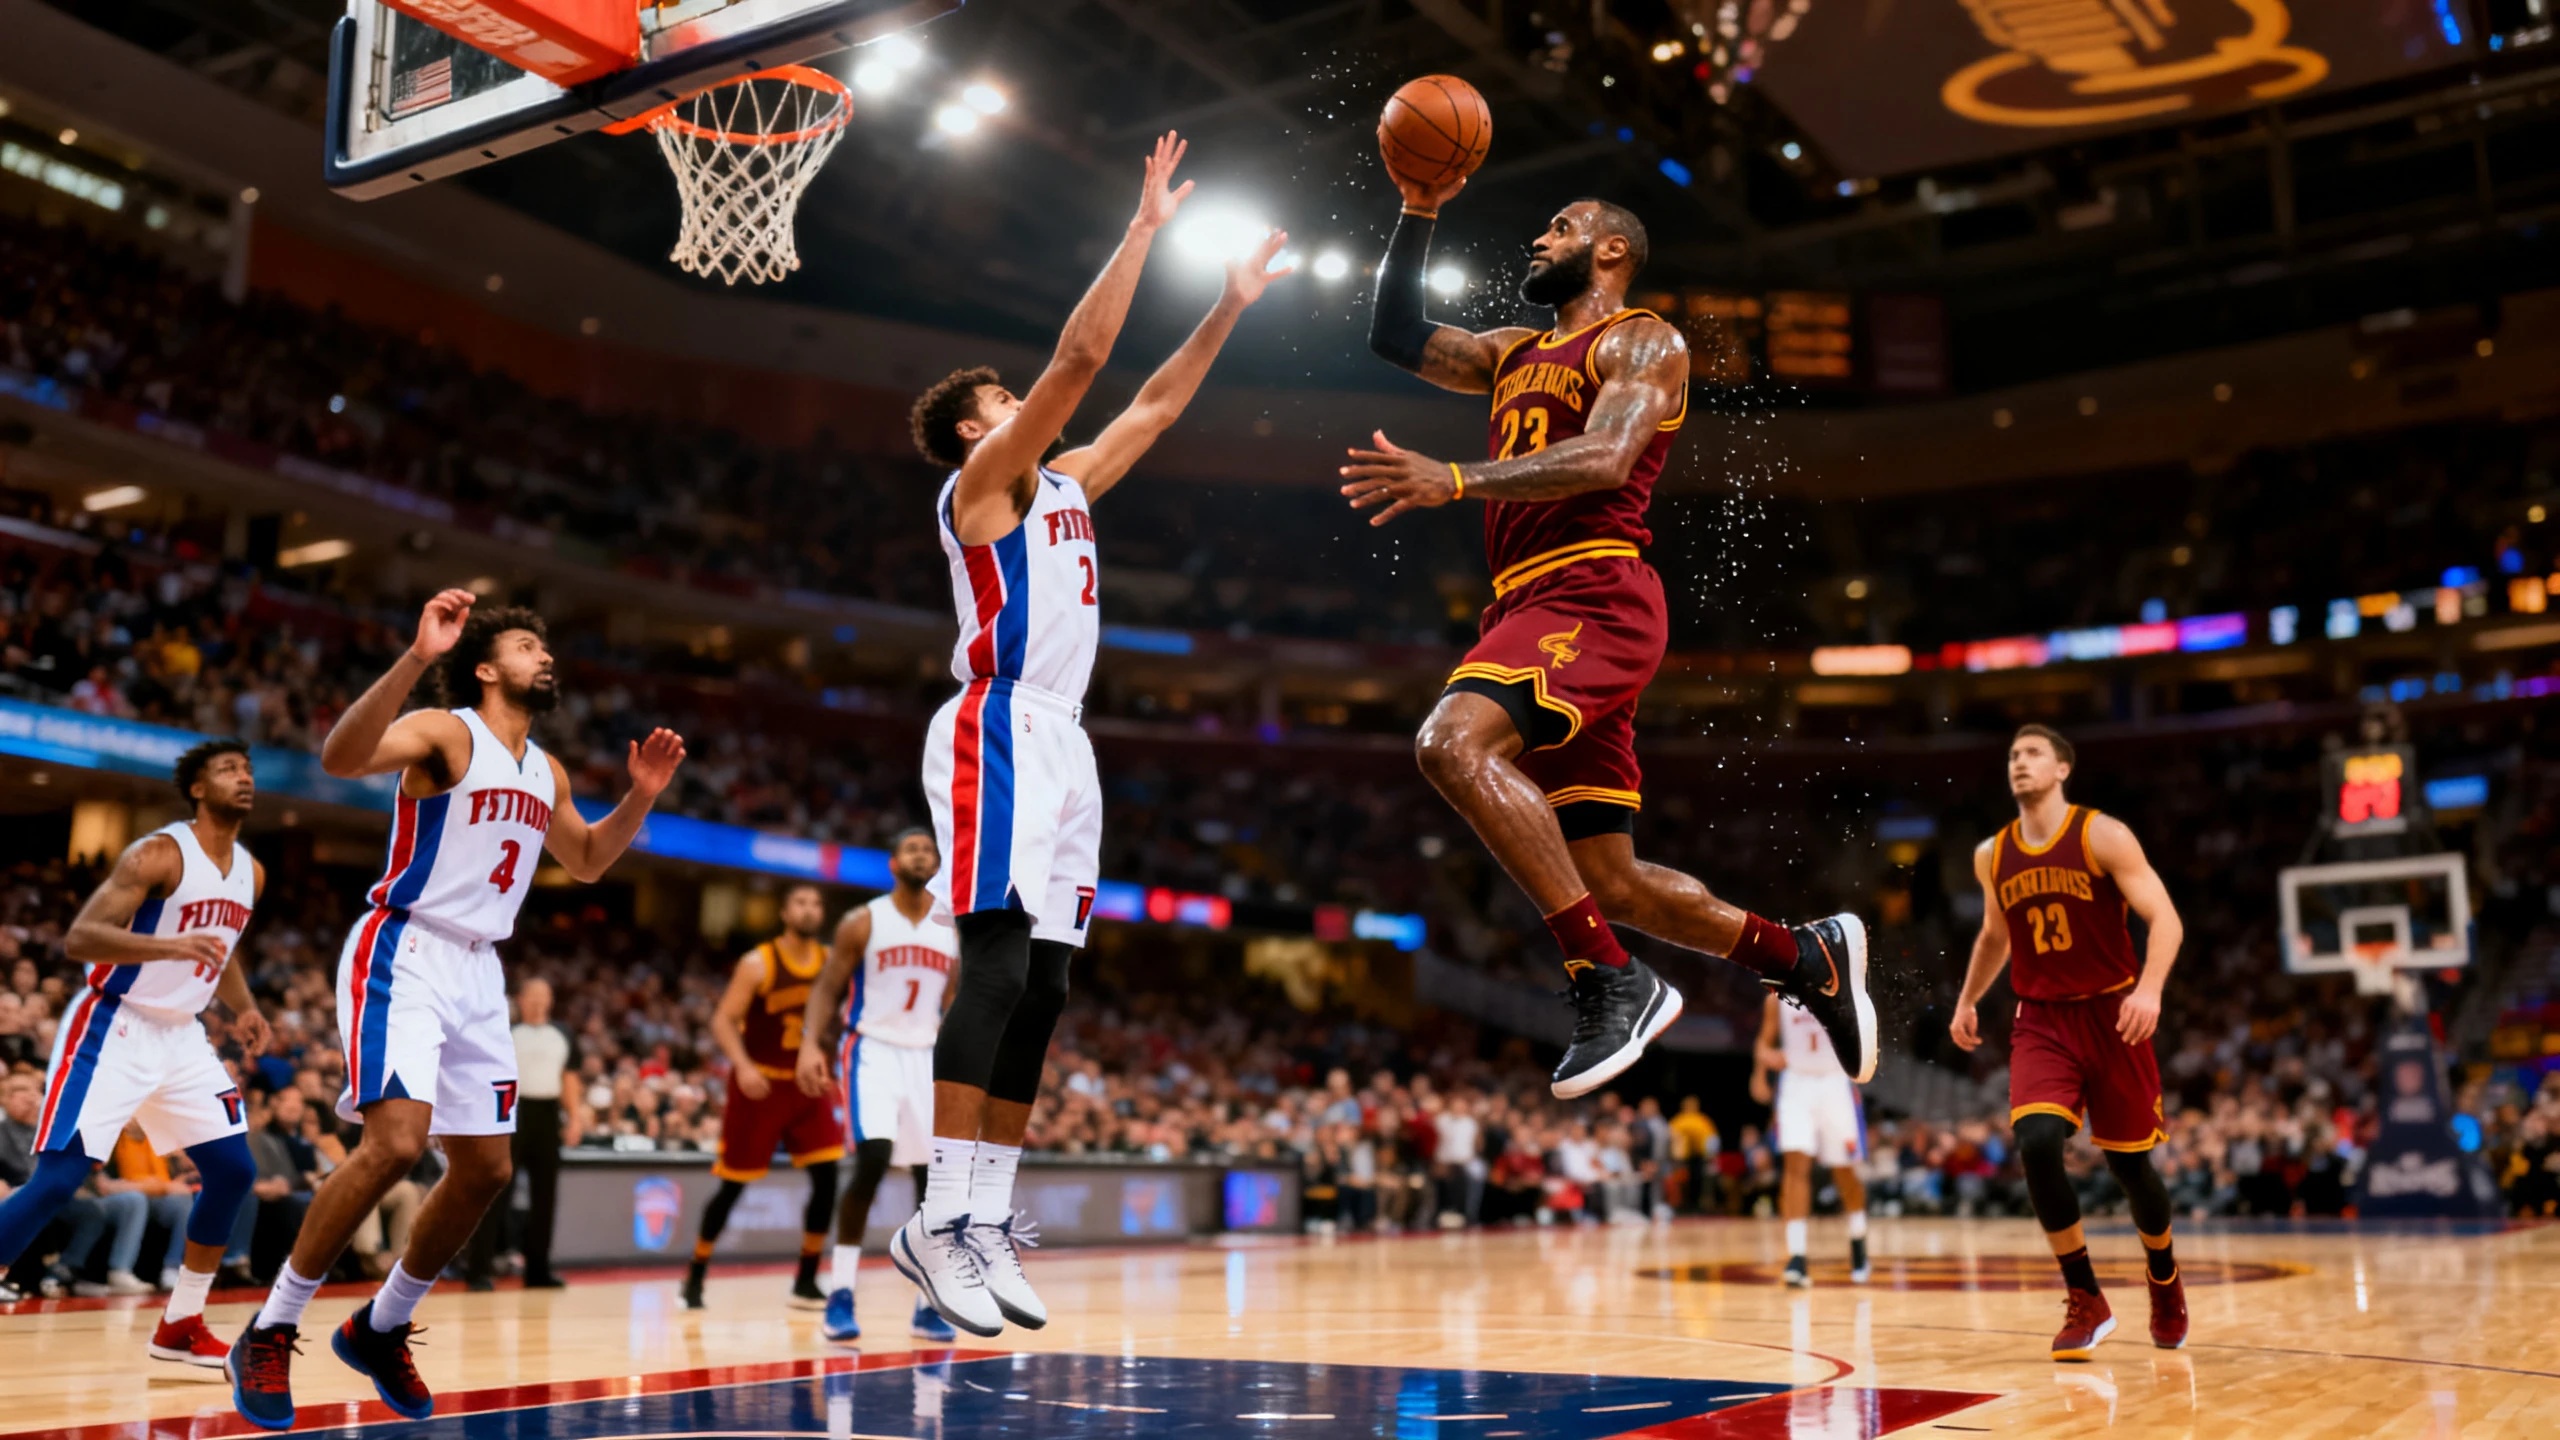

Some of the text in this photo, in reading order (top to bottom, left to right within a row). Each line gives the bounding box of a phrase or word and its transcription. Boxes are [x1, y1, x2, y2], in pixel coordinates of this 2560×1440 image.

[1079, 555, 1097, 606] 2
[2027, 902, 2073, 955] 23
[903, 979, 920, 1012] 7
